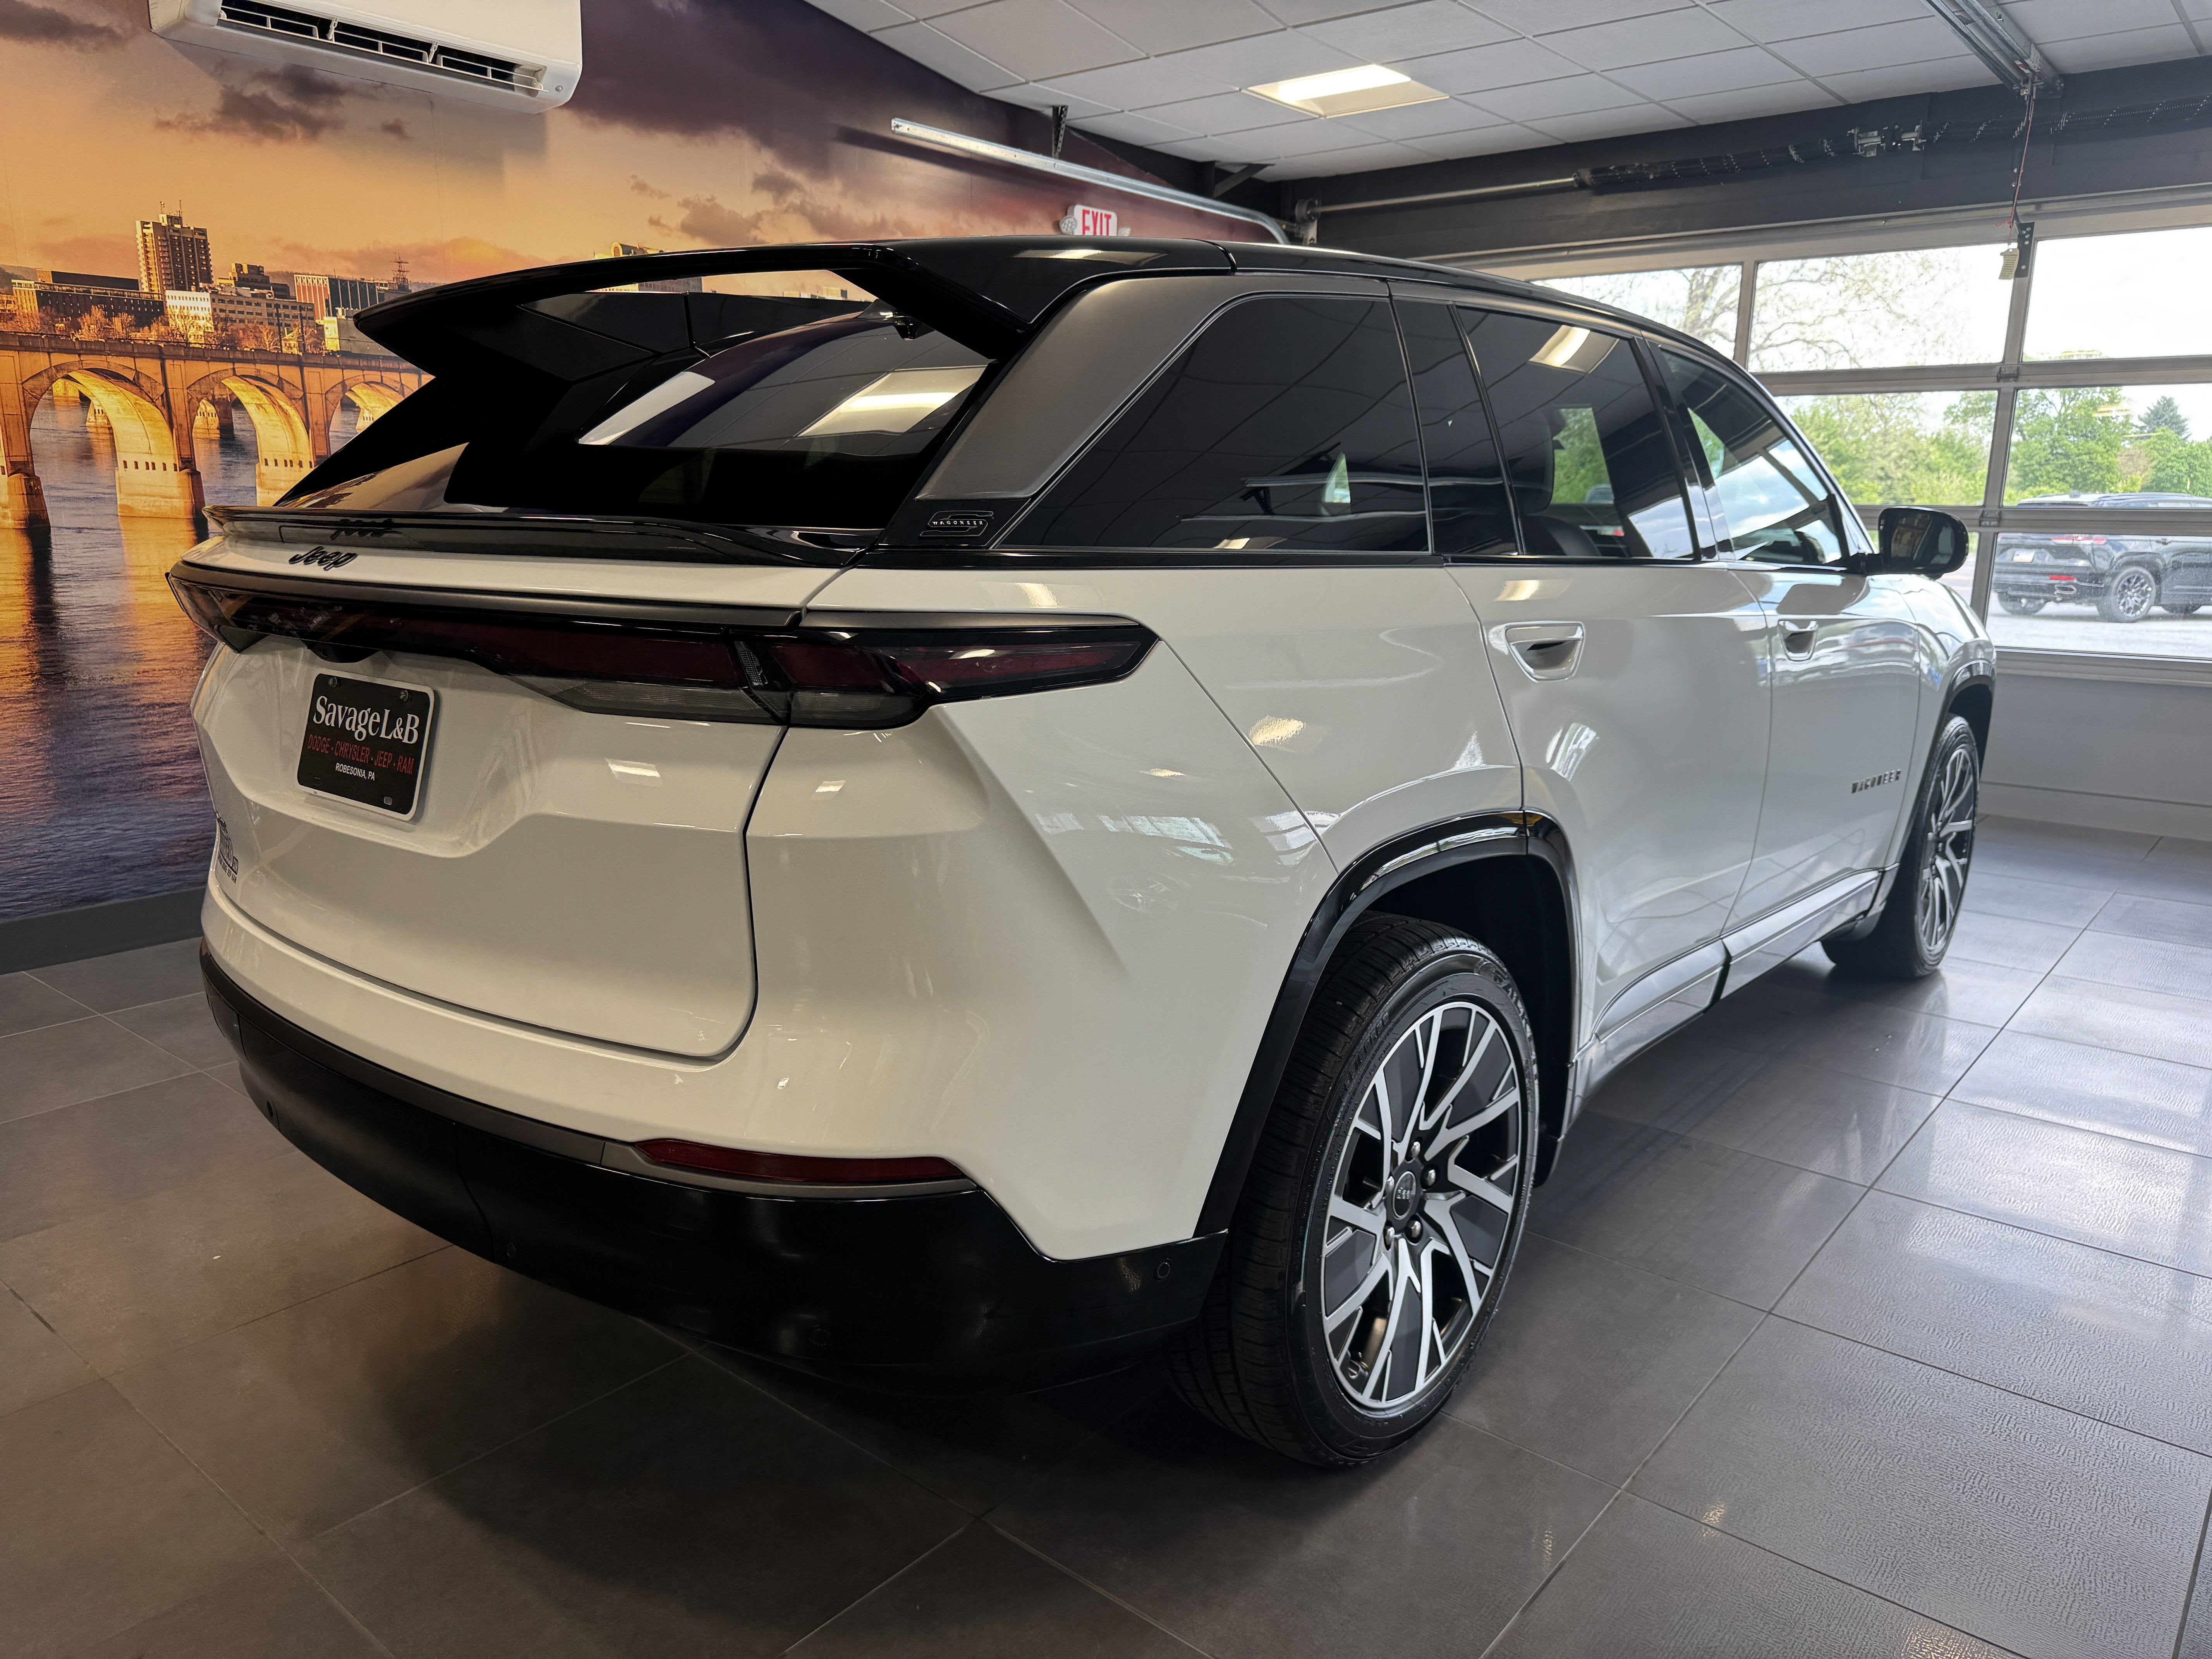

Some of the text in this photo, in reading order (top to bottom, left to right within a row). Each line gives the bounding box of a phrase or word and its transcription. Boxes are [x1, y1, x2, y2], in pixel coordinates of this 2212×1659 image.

[1082, 209, 1111, 236] EXIT
[289, 546, 359, 571] Jeep
[307, 734, 414, 774] DODGE CHRYSLER JEEP RAM
[335, 763, 375, 781] ROBESONIA, PA
